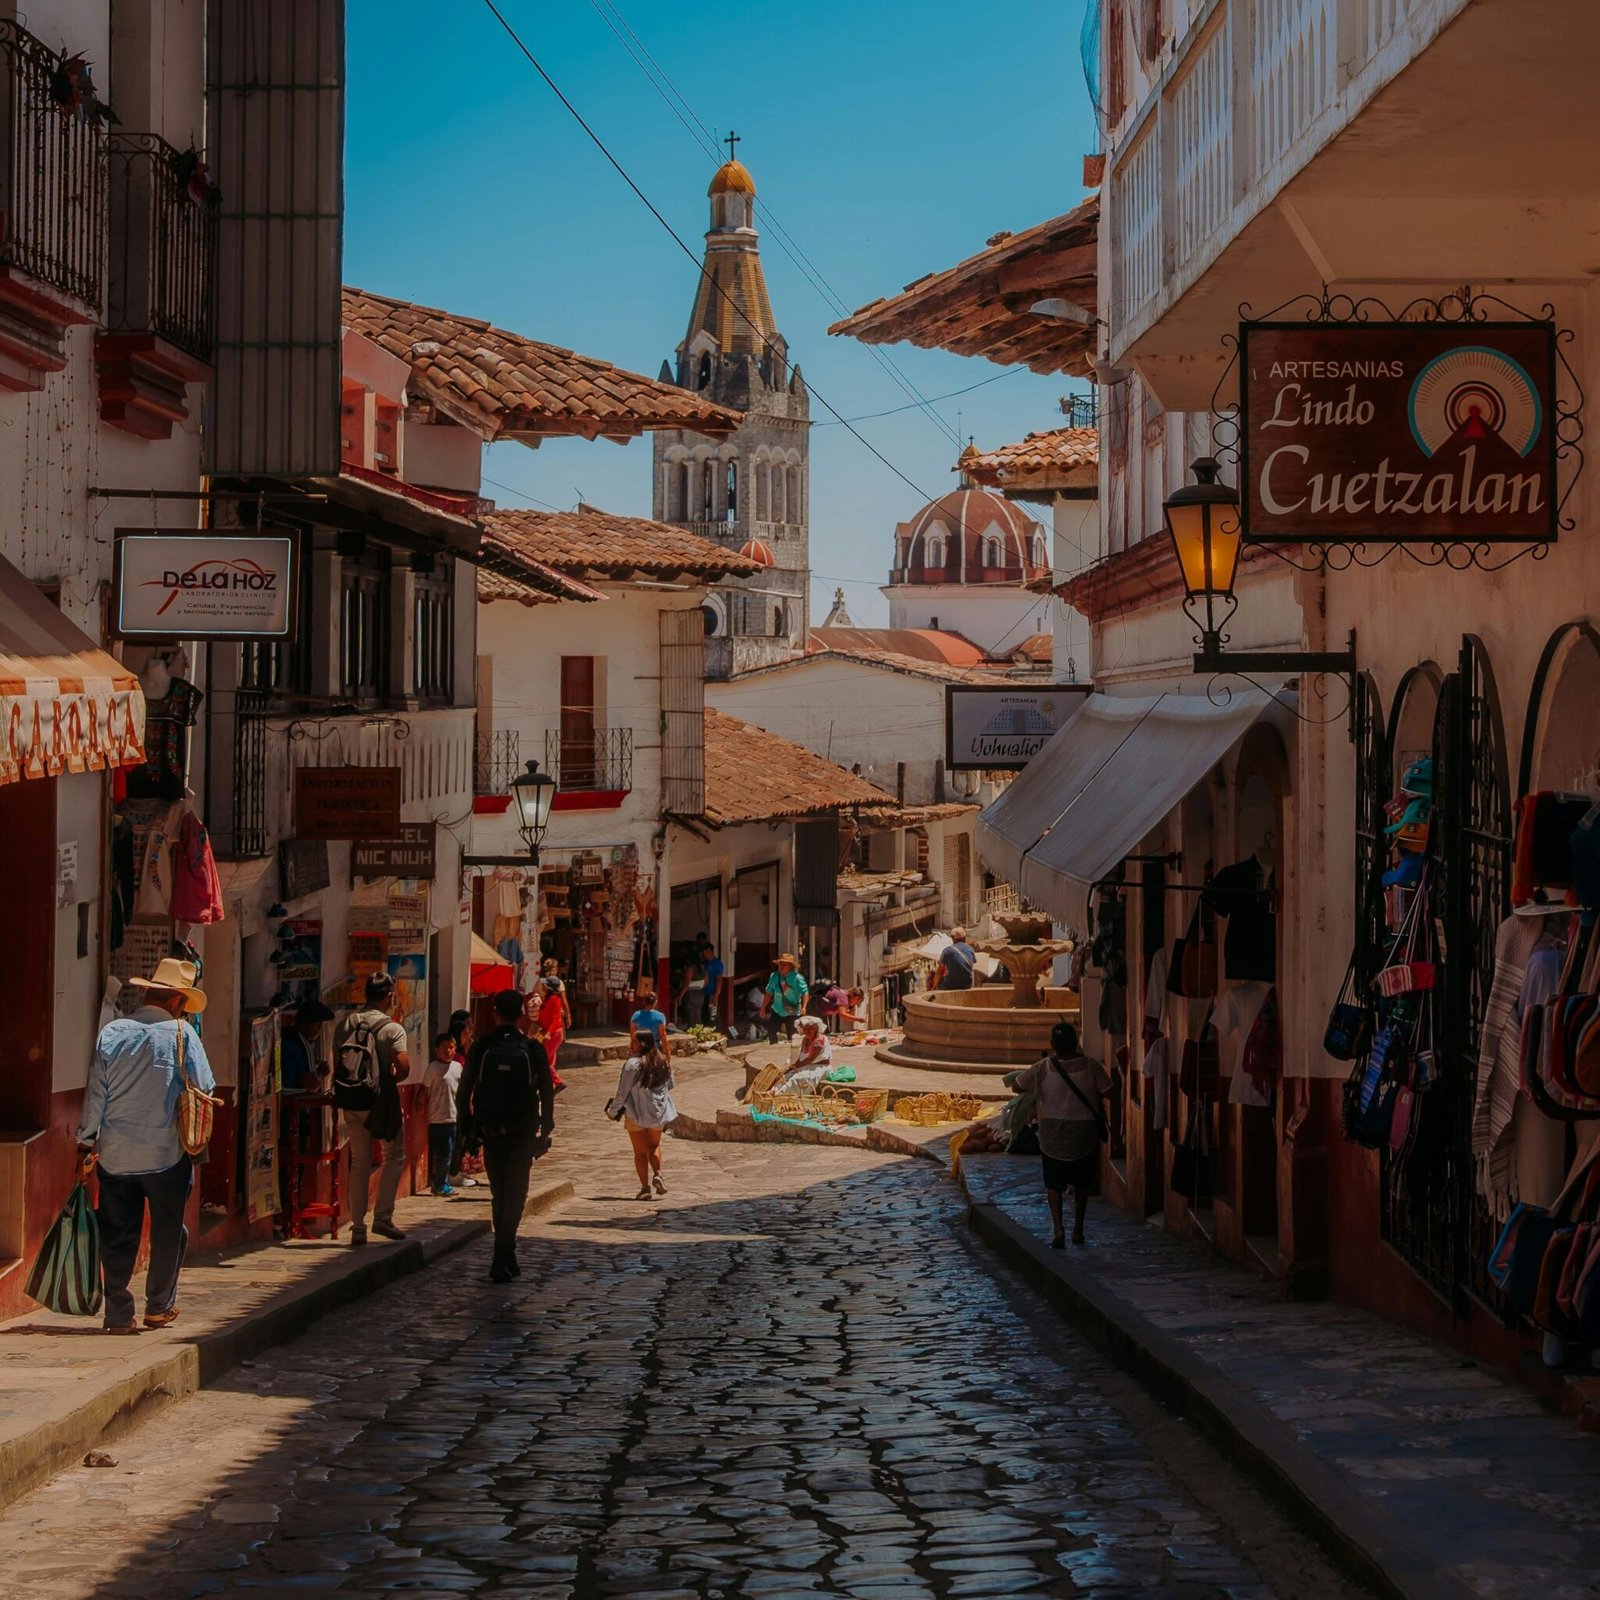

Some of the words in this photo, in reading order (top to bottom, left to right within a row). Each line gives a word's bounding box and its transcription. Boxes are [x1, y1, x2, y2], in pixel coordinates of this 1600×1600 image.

[1269, 361, 1404, 378] ARTESANIAS
[1259, 444, 1545, 515] Cuetzalan
[220, 603, 266, 611] Experiencia
[8, 697, 144, 764] CABORCA
[357, 850, 385, 864] NIC
[391, 850, 432, 865] NIUH
[389, 901, 423, 909] INTERNET
